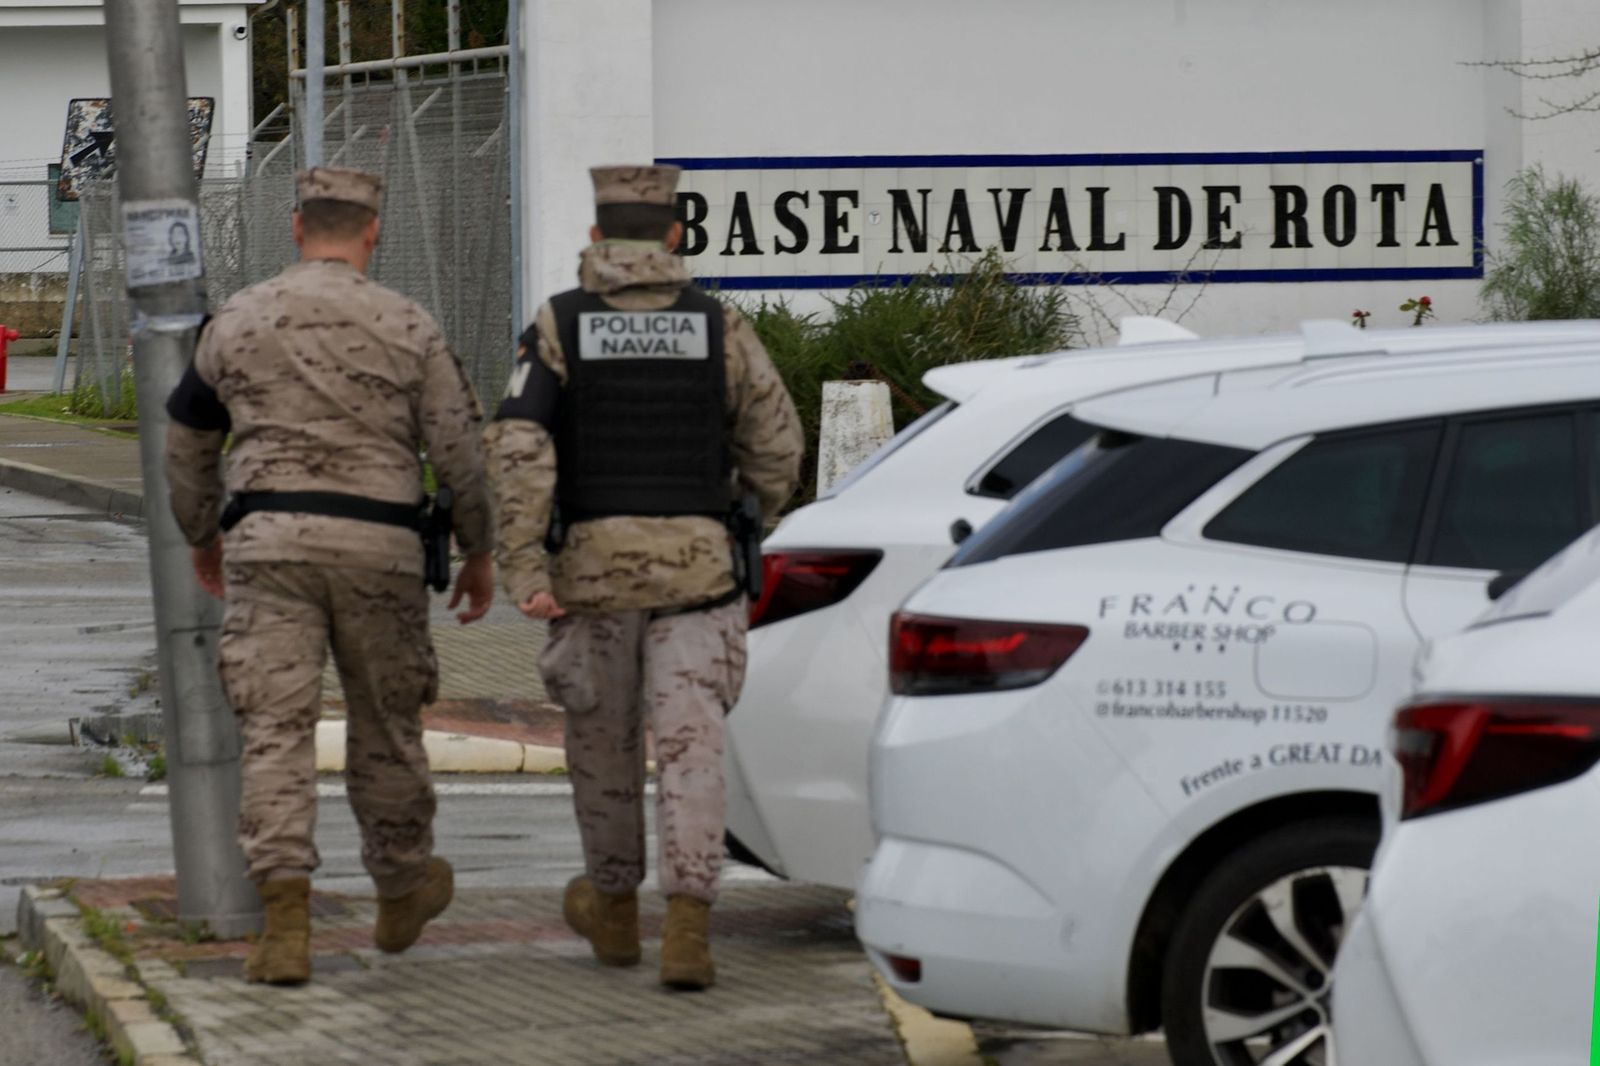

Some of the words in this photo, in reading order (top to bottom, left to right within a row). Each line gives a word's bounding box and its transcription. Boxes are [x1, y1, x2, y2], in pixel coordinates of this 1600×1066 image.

[676, 190, 859, 256] BASE
[887, 187, 1126, 253] NAVAL
[1152, 185, 1243, 251] DE
[1269, 182, 1460, 249] ROTA
[590, 315, 696, 336] POLICIA
[601, 338, 686, 355] NAVAL
[1099, 593, 1317, 625] FRANCO
[1124, 621, 1206, 640] BARBER
[1211, 622, 1277, 644] SHOP
[1112, 679, 1148, 696] 613
[1251, 754, 1262, 768] a
[1268, 743, 1342, 766] GREAT
